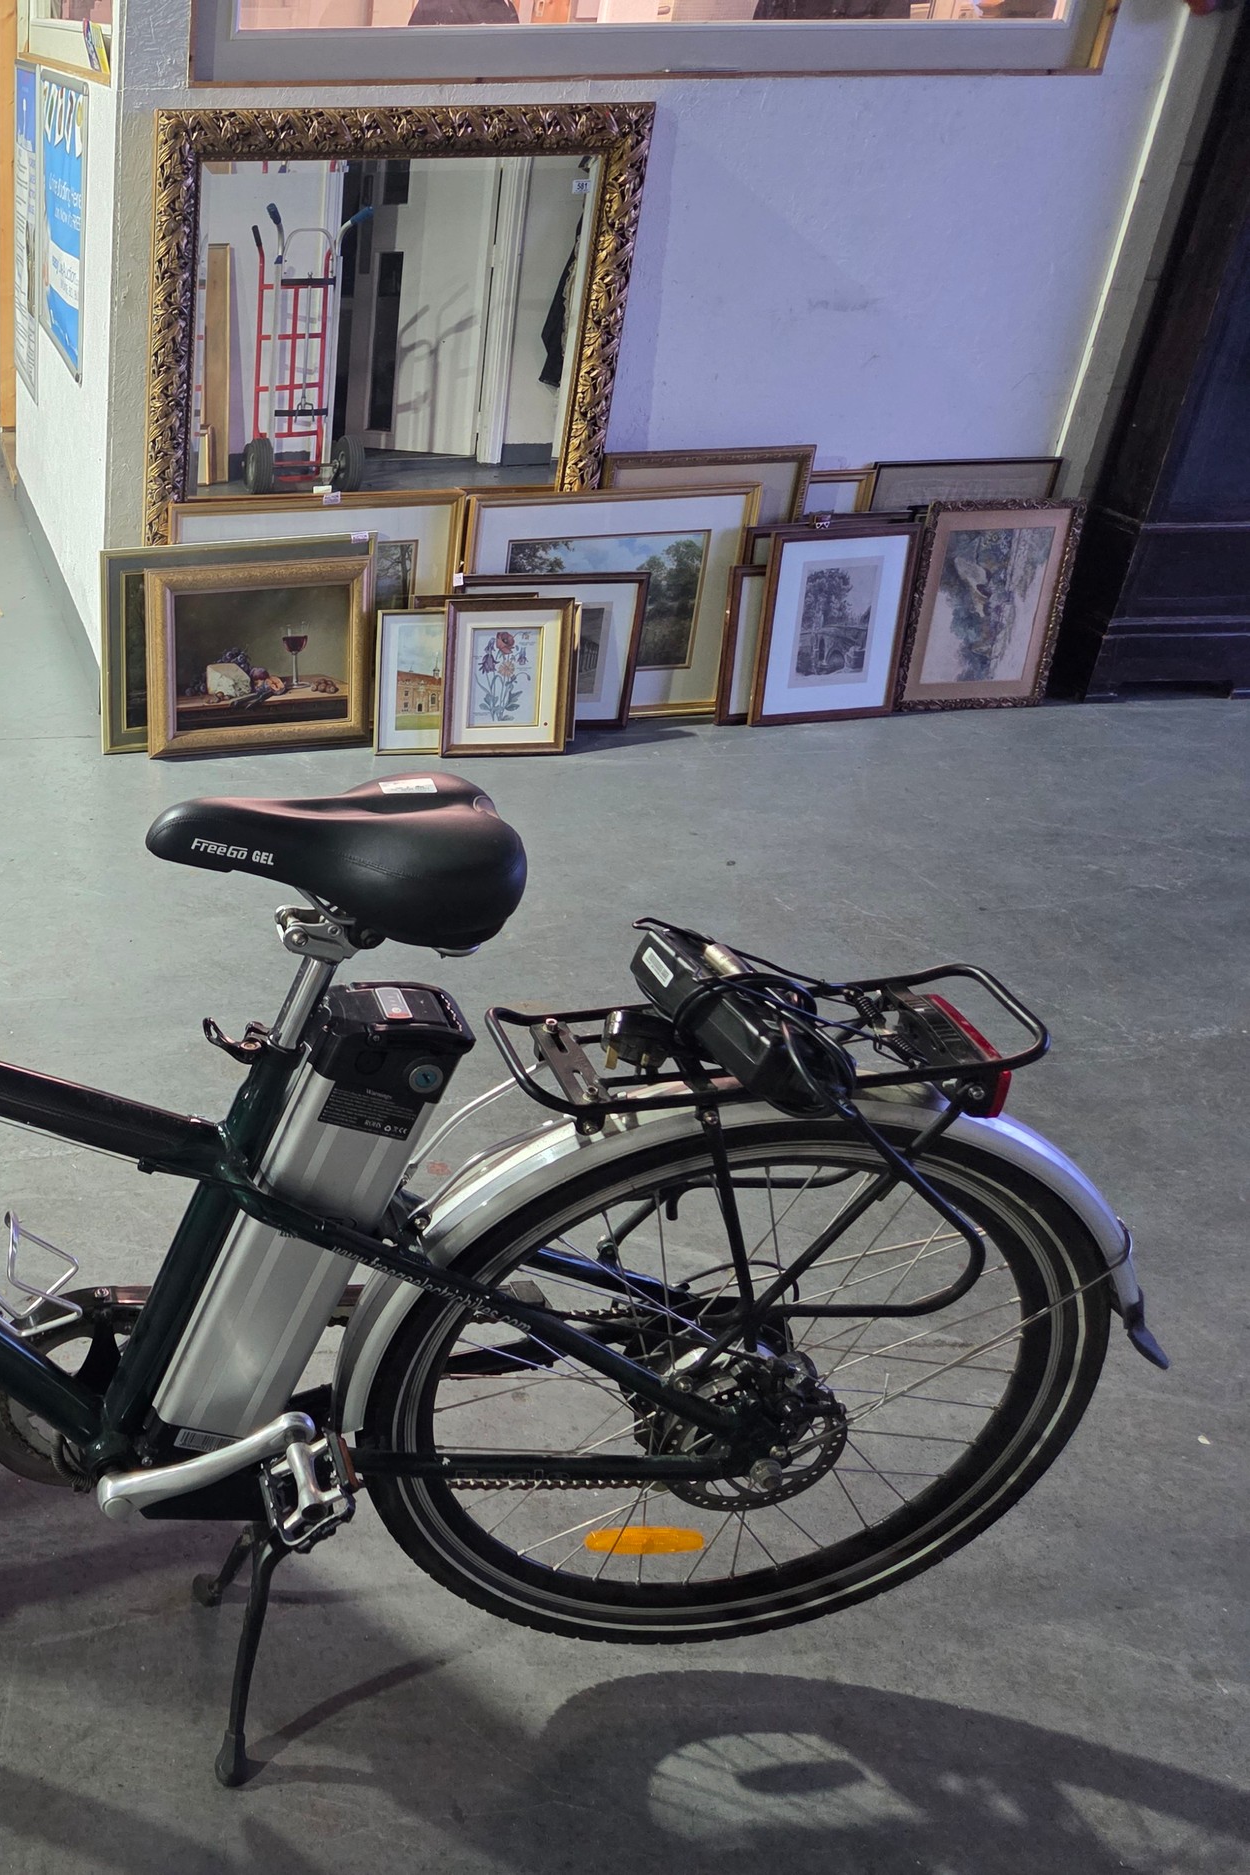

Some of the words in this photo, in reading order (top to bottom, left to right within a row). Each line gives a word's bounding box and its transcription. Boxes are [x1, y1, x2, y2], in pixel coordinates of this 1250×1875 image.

[577, 182, 588, 191] 581
[191, 838, 248, 860] FreeGo
[252, 850, 275, 866] GEL
[332, 1245, 532, 1332] www.freegoelectricbikes.com
